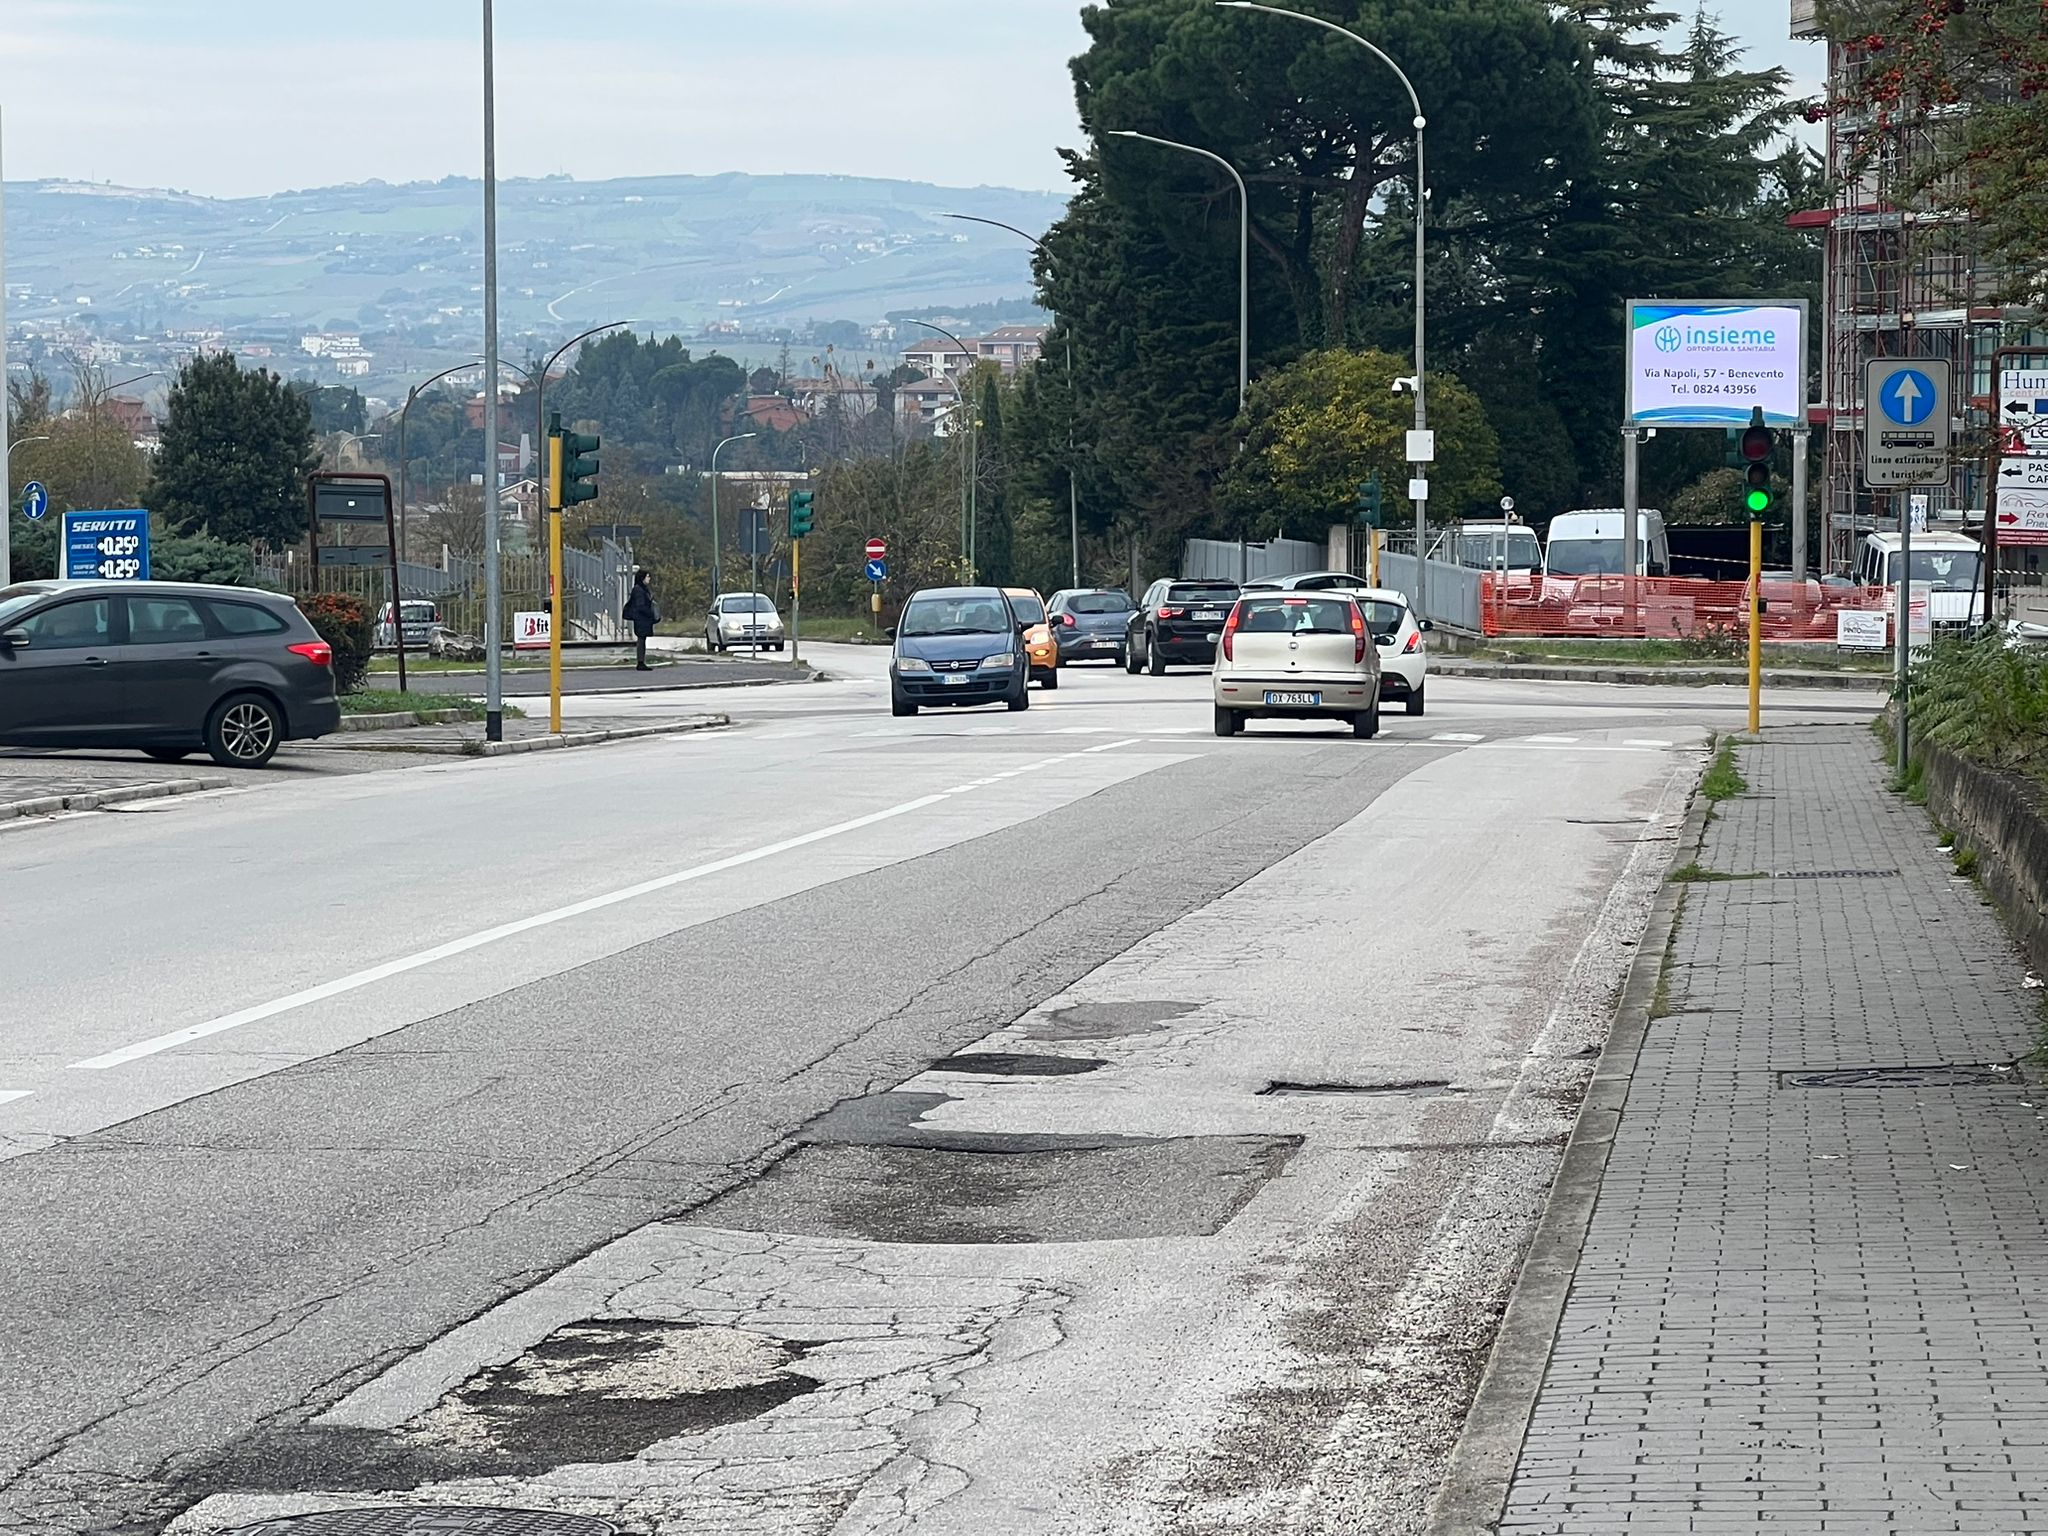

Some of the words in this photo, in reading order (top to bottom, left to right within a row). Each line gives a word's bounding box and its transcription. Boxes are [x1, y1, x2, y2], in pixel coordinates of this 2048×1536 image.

[1686, 326, 1776, 344] insieme
[1645, 368, 1660, 378] Via
[1663, 368, 1700, 380] Napoli,
[1703, 368, 1716, 378] 57
[1728, 368, 1784, 379] Benevento
[1671, 384, 1690, 394] Tel.
[1693, 384, 1720, 394] 0824
[1723, 384, 1757, 394] 43956
[71, 520, 136, 532] SERVITO
[1272, 693, 1283, 703] DX
[1286, 693, 1313, 703] 763LL
